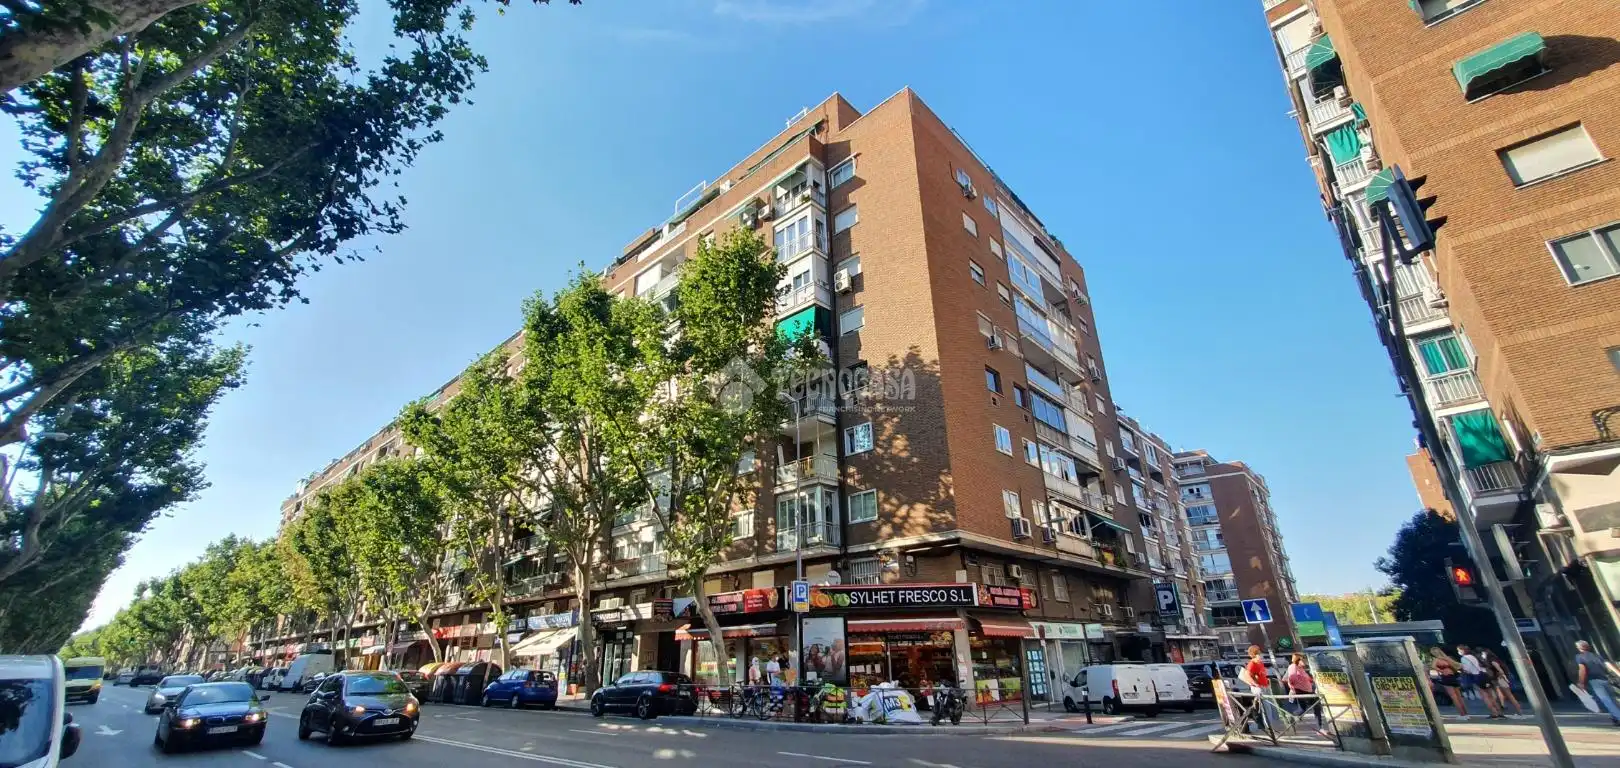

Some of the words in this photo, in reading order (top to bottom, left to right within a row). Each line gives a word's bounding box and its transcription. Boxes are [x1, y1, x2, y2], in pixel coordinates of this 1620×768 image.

[850, 591, 895, 605] SYLHET
[899, 589, 947, 603] FRESCO
[950, 589, 971, 602] S.L.
[1157, 591, 1174, 610] P
